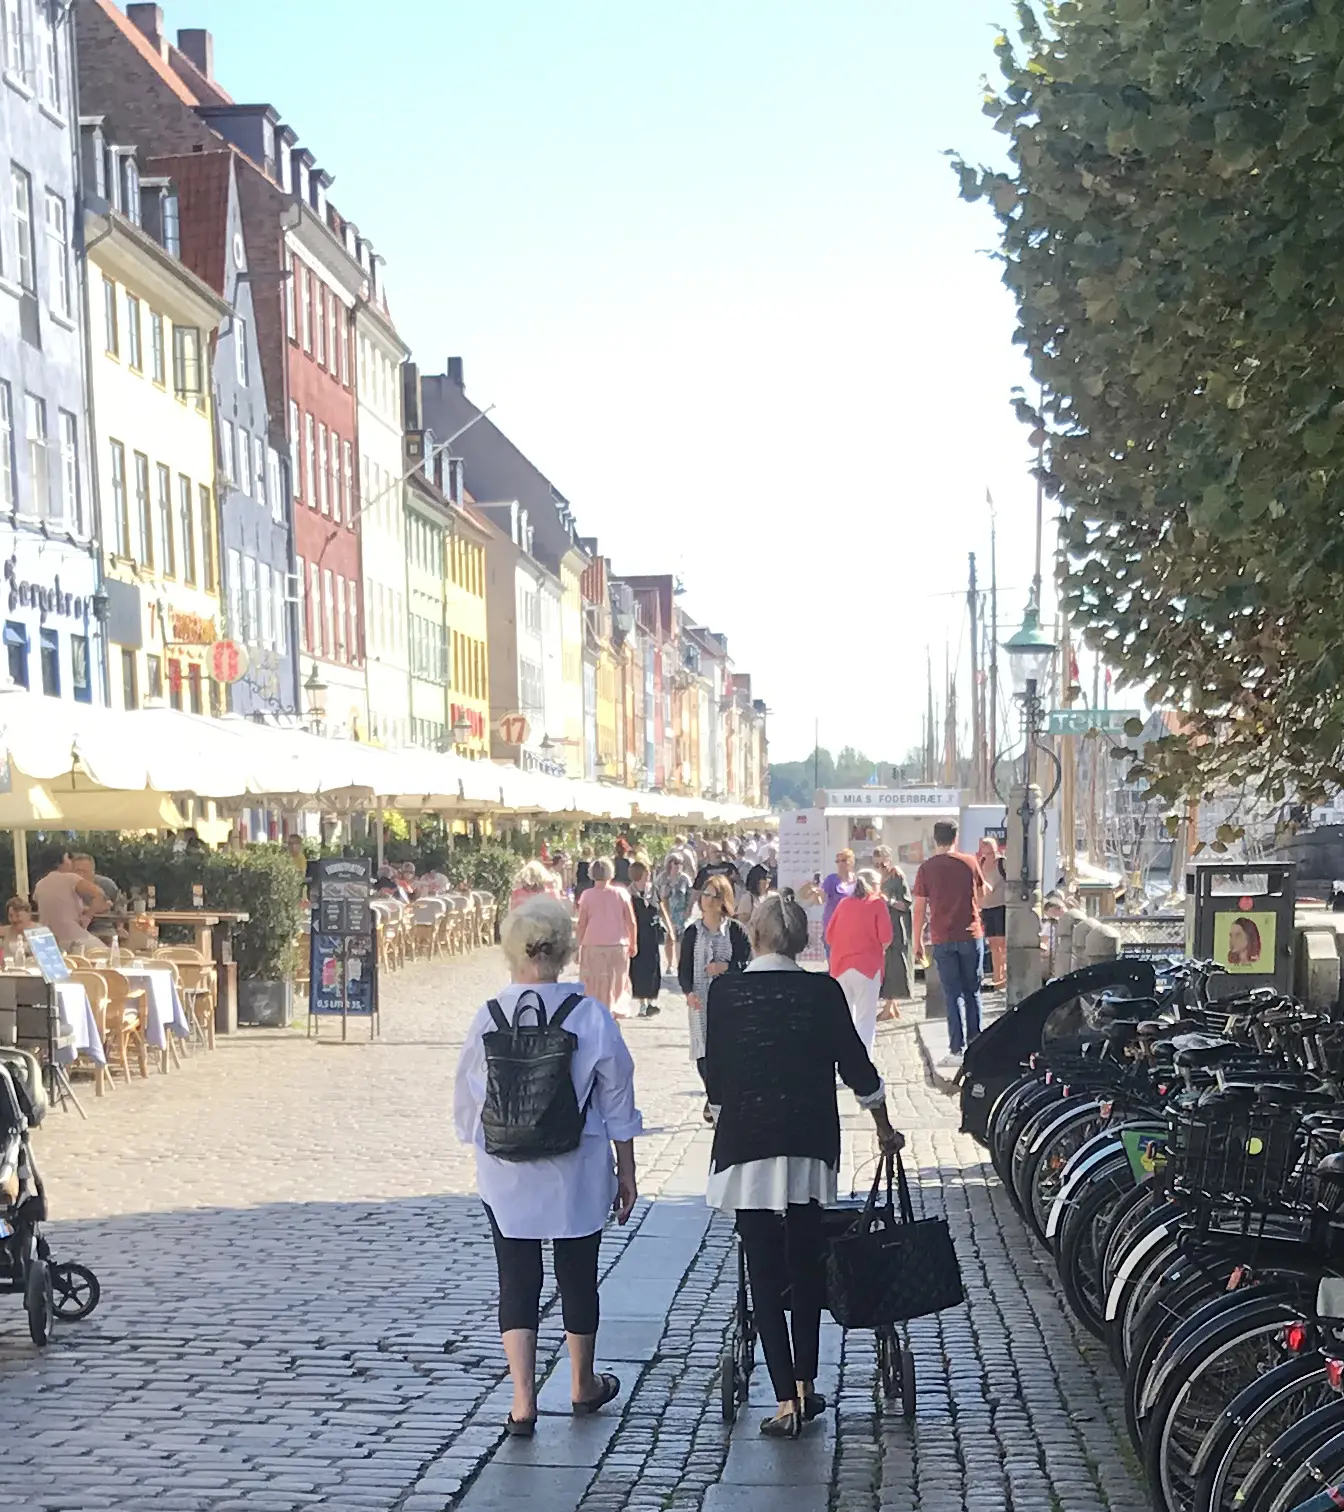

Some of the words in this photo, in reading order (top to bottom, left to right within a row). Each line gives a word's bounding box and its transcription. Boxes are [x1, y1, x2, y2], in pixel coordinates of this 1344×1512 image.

[501, 717, 526, 743] 17
[878, 794, 943, 803] FODERBRÆT
[330, 999, 350, 1009] LITR
